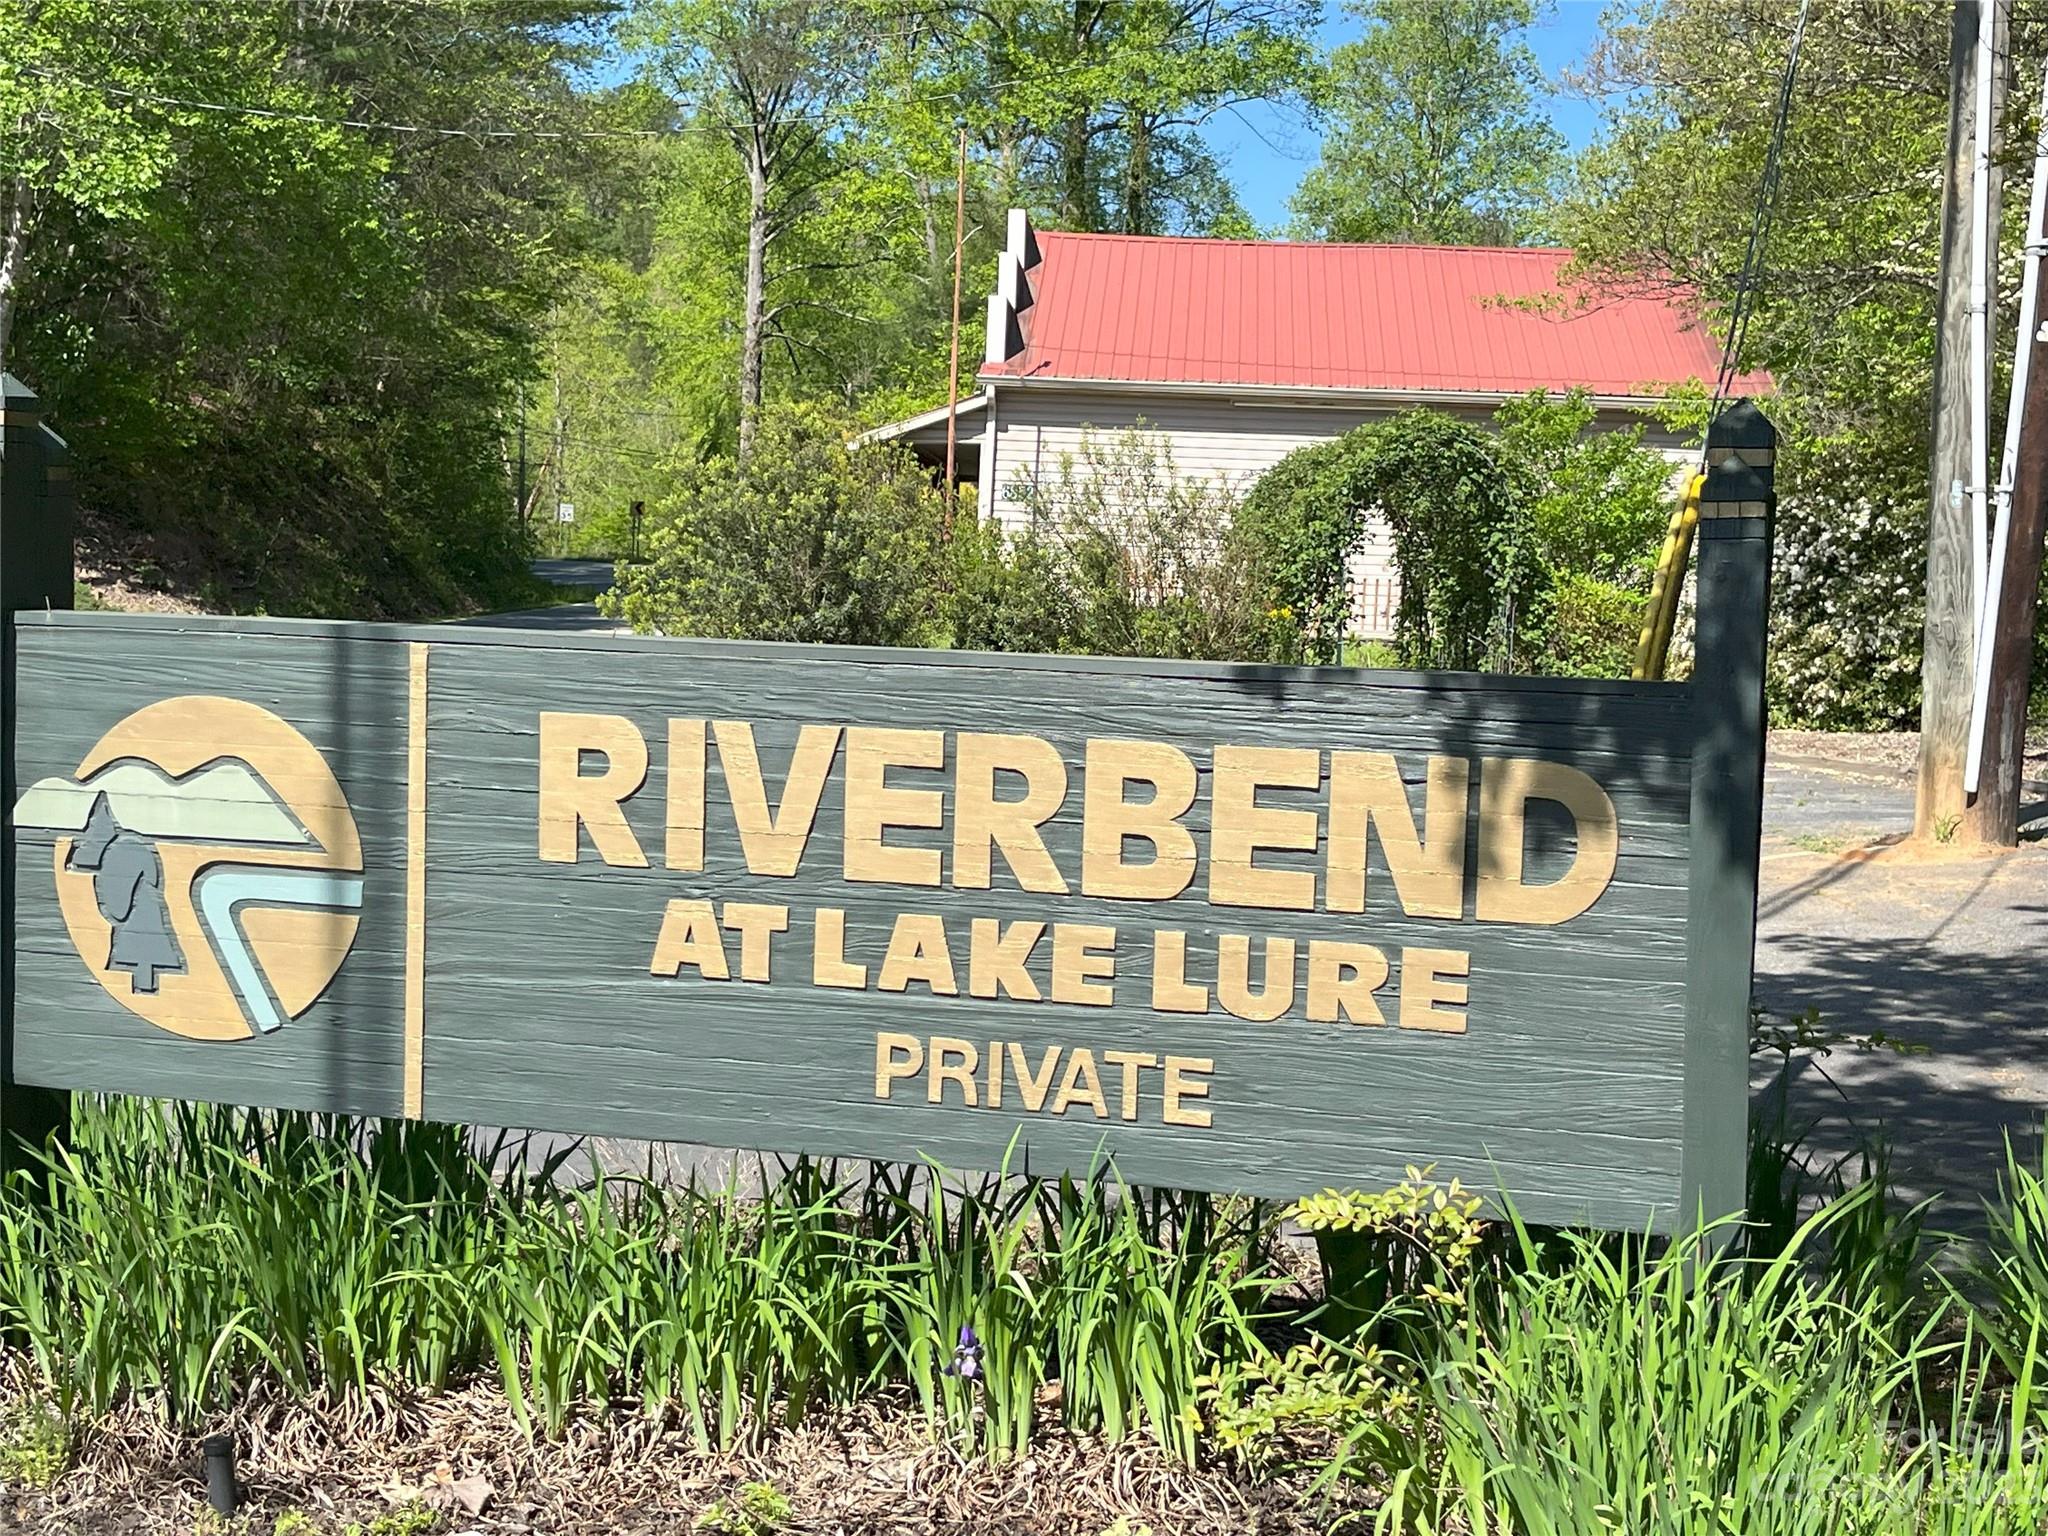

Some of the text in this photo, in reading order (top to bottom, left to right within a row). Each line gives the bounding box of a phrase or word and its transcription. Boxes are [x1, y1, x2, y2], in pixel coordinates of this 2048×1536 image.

[538, 711, 1618, 925] RIVERBEND
[649, 898, 1471, 1034] AT LAKE LURE
[874, 1032, 1214, 1127] PRIVATE
